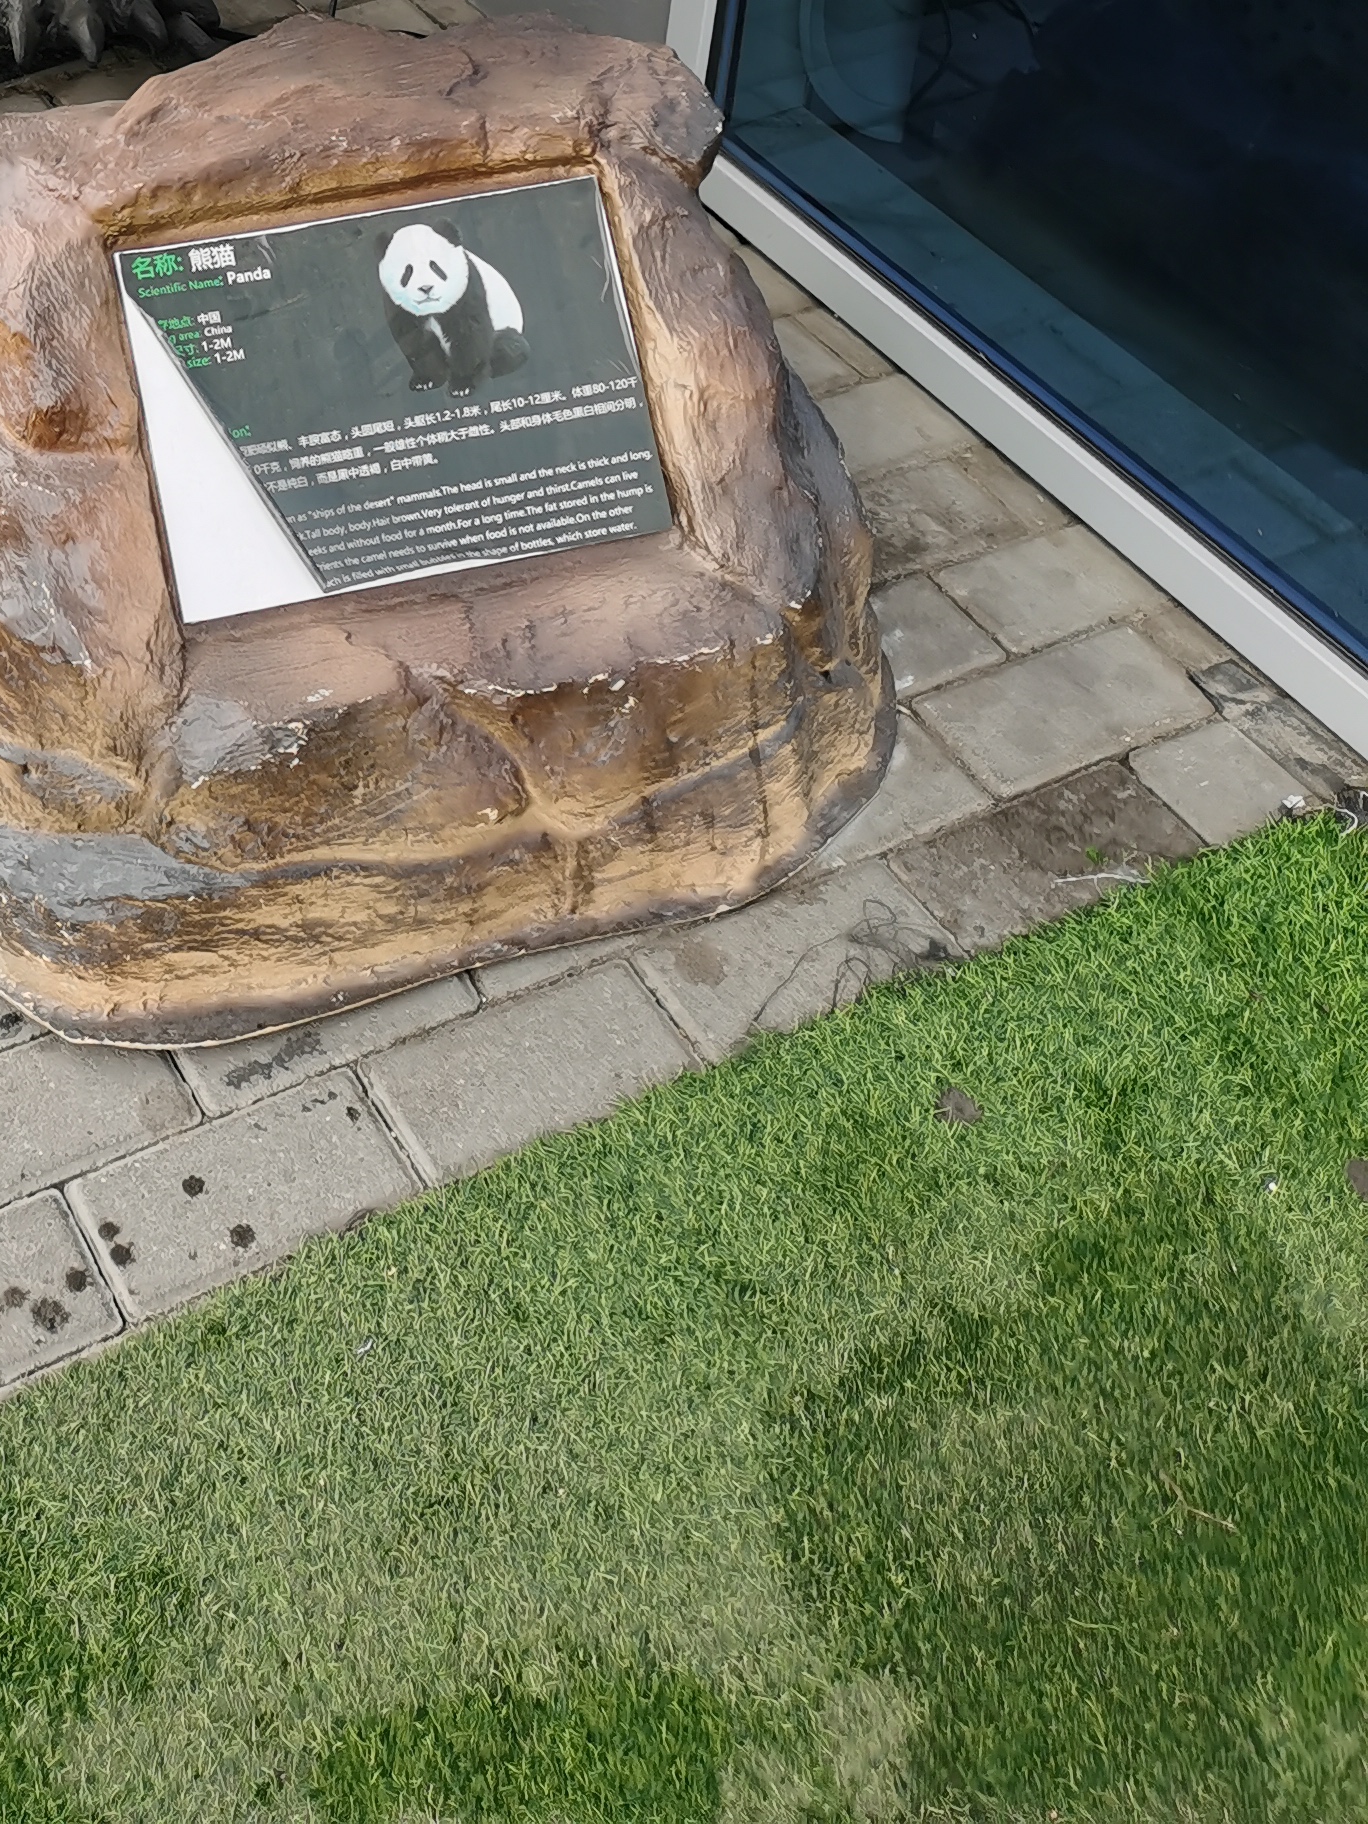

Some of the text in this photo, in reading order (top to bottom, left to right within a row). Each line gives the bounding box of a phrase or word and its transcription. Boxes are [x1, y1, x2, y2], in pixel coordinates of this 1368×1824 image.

[186, 241, 237, 272] 熊猫
[137, 264, 272, 299] Scientific Name: Panda
[196, 309, 221, 325] 中国
[203, 322, 233, 337] China
[200, 336, 232, 352] 1-2M
[213, 348, 245, 364] 1-2M
[296, 513, 307, 522] as
[335, 504, 347, 516] of
[346, 501, 362, 514] the
[459, 478, 483, 493] head
[483, 477, 493, 488] is
[493, 472, 518, 486] small
[518, 468, 537, 481] and
[537, 465, 554, 478] the
[554, 461, 577, 475] neck
[577, 459, 587, 470] is
[586, 455, 609, 469] thick
[609, 451, 628, 464] and
[442, 498, 479, 515] tolerant
[479, 495, 492, 508] of
[491, 489, 526, 508] hunger
[525, 486, 544, 499] and
[603, 473, 621, 484] can
[621, 468, 638, 481] live
[327, 540, 345, 553] and
[345, 534, 380, 550] without
[380, 529, 402, 543] food
[403, 527, 417, 539] for
[472, 516, 480, 525] a
[481, 510, 503, 526] long
[543, 500, 557, 512] fat
[557, 494, 588, 509] stored
[588, 492, 599, 503] in
[598, 489, 616, 501] the
[615, 484, 644, 500] hump
[643, 482, 653, 493] is
[343, 555, 360, 568] the
[360, 549, 387, 564] camel
[387, 544, 415, 559] needs
[415, 542, 427, 554] to
[426, 536, 458, 552] survive
[458, 531, 484, 545] when
[484, 526, 507, 540] food
[507, 524, 517, 536] is
[517, 521, 534, 534] not
[591, 507, 607, 520] the
[607, 502, 634, 517] other
[341, 572, 351, 583] is
[351, 567, 374, 581] filled
[374, 563, 395, 576] with
[395, 559, 420, 572] small
[480, 543, 508, 558] shape
[508, 541, 520, 553] of
[554, 529, 583, 545] which
[583, 525, 607, 539] store
